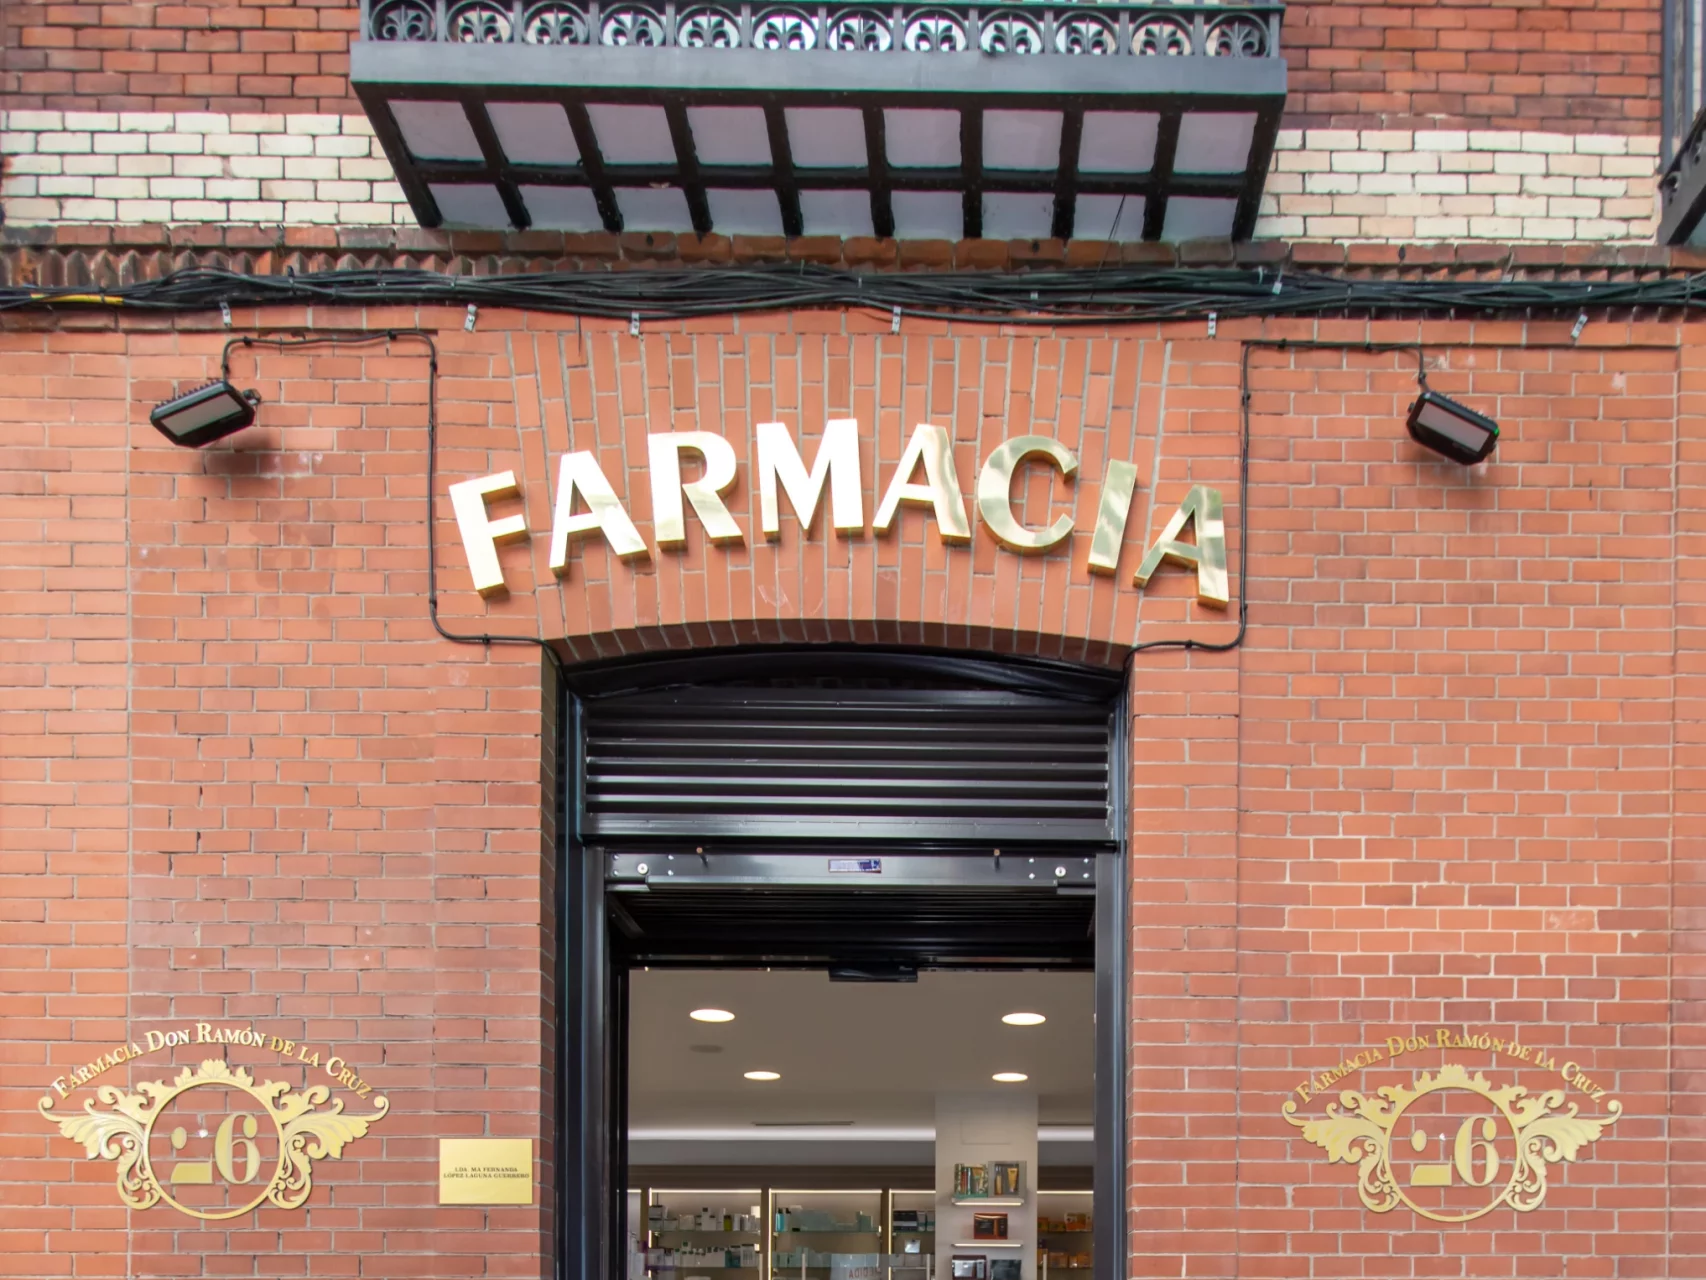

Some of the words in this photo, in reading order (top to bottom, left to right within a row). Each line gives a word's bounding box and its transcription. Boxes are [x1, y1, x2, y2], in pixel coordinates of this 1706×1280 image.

[447, 417, 1230, 610] FARMACIA
[51, 1042, 143, 1099] FARMACIA
[144, 1029, 191, 1053] DON
[195, 1022, 267, 1049] RAMÓN
[270, 1035, 296, 1057] DE
[297, 1046, 320, 1067] LA
[325, 1056, 375, 1100] CRUZ
[1294, 1047, 1383, 1105] FARMACIA
[1384, 1034, 1430, 1058] DON
[1435, 1028, 1505, 1053] RAMÓN
[1507, 1041, 1531, 1061] DE
[1534, 1052, 1556, 1072] LA
[1560, 1061, 1608, 1104] CRUZ
[170, 1112, 261, 1185] 26
[1410, 1115, 1500, 1187] 26
